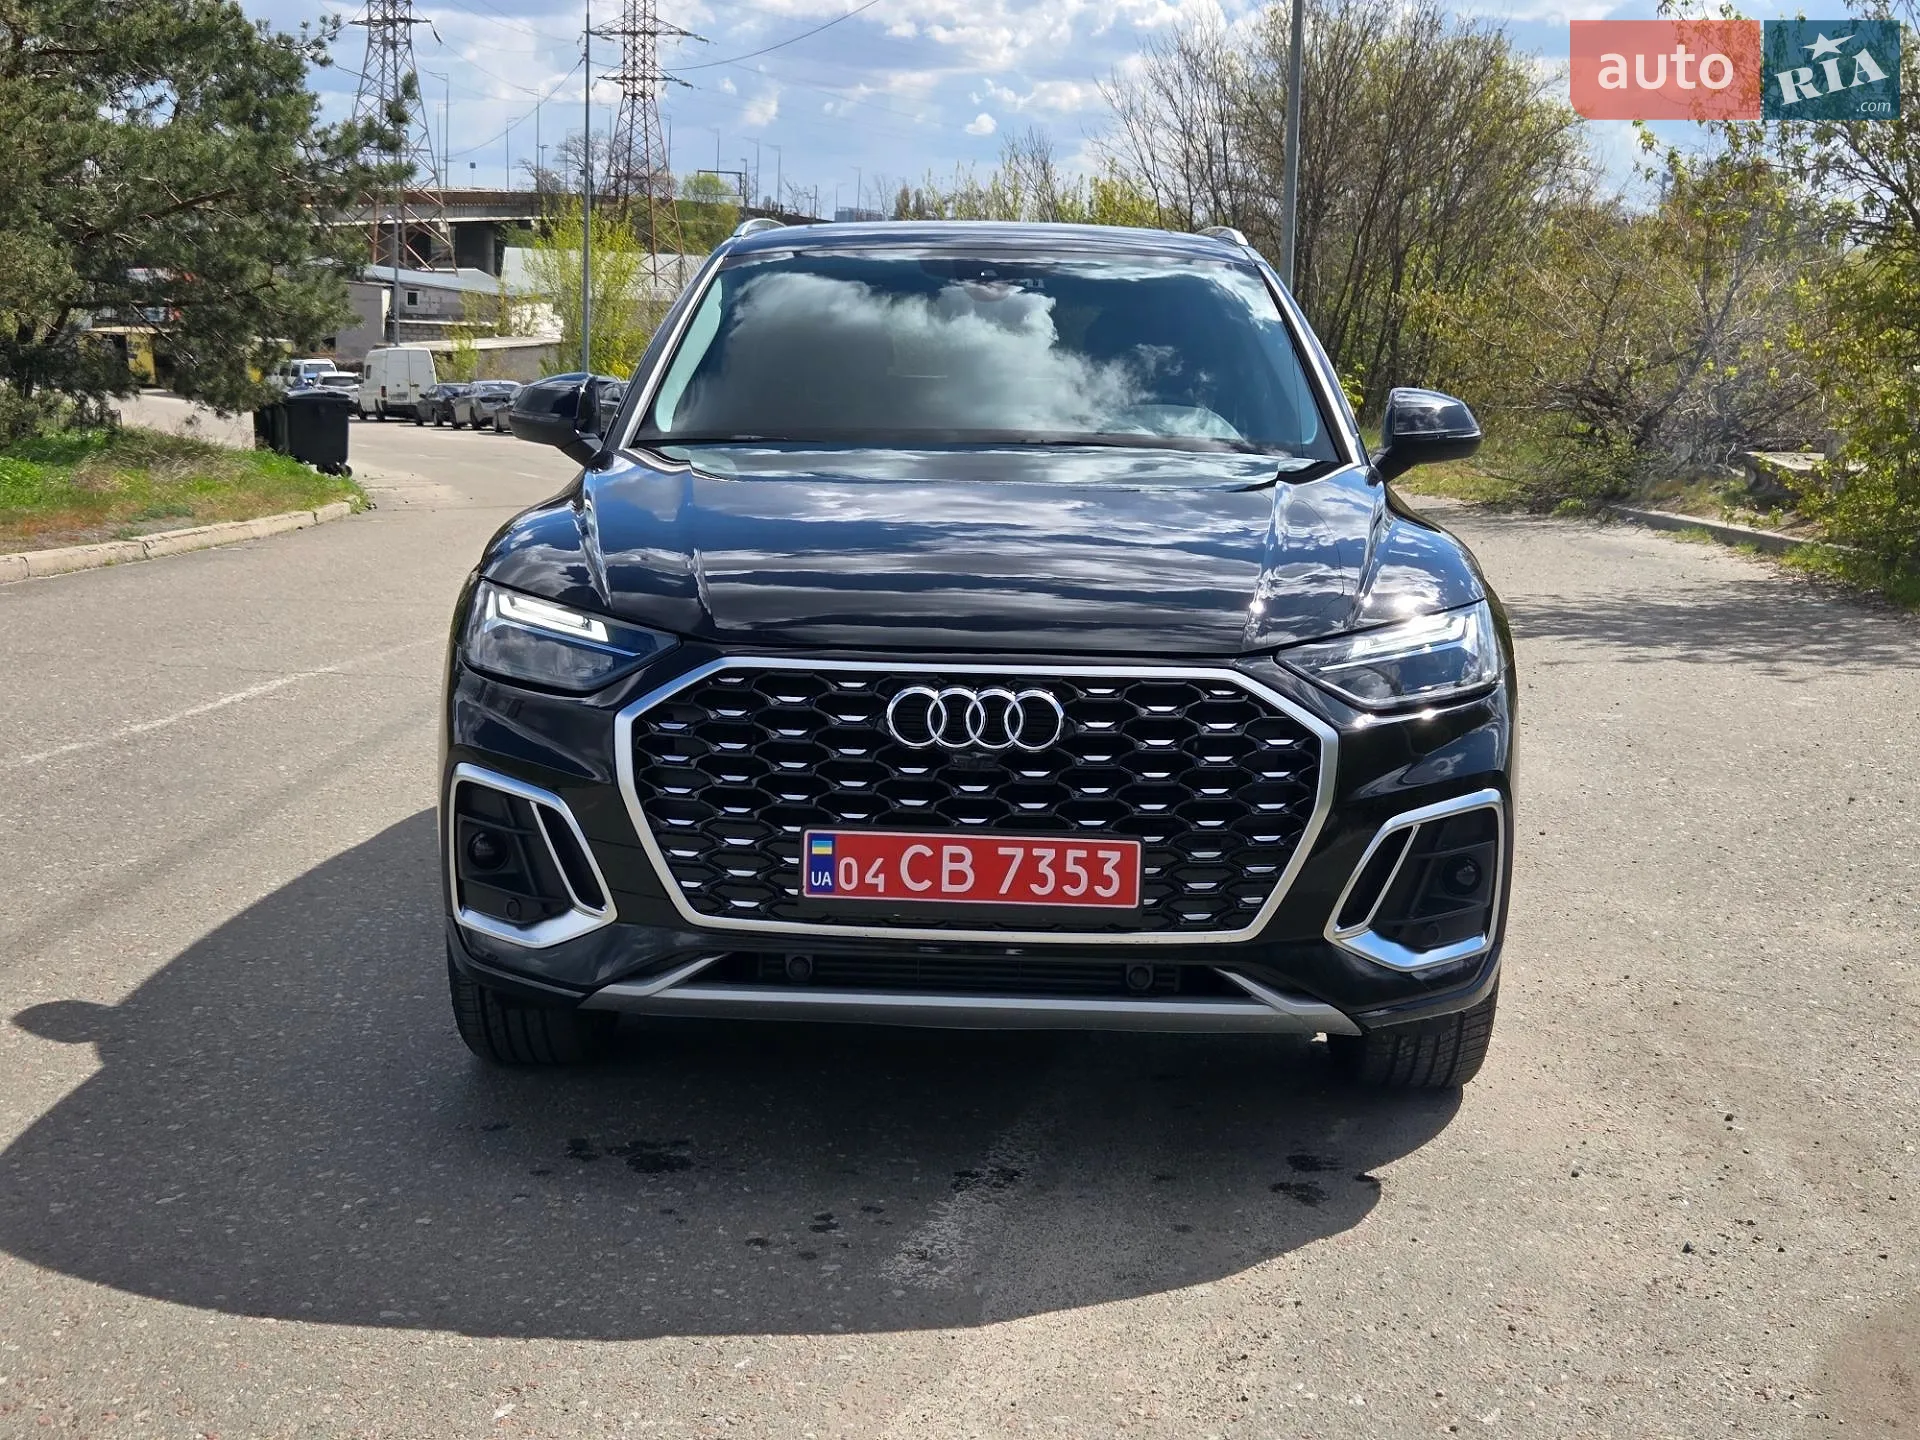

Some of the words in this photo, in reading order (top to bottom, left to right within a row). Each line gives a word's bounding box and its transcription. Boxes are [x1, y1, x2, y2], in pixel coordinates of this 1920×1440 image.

[811, 871, 832, 887] UA
[838, 857, 884, 892] 04
[900, 844, 975, 893] CB
[998, 847, 1121, 898] 7353
